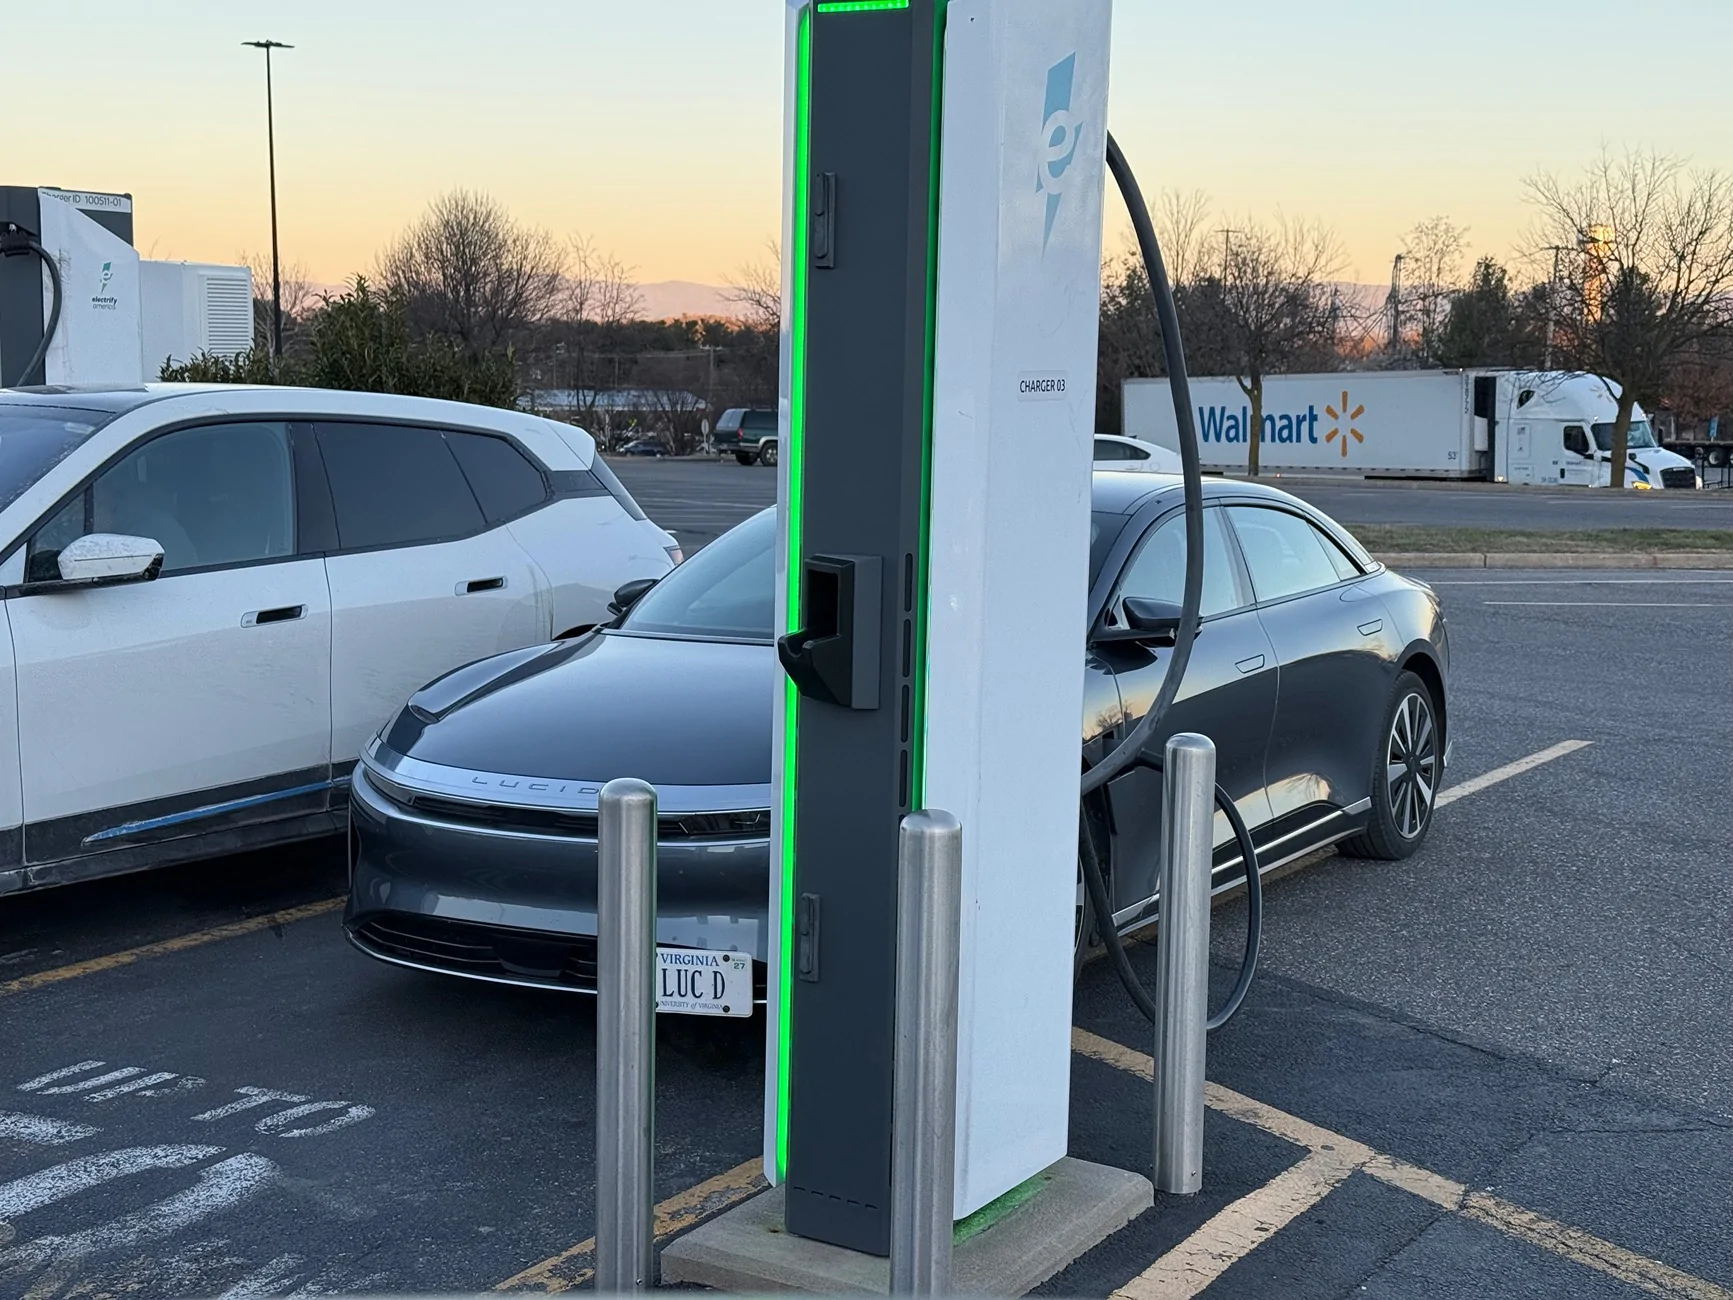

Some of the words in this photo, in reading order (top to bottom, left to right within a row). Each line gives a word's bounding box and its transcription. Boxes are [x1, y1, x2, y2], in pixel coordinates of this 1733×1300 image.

[72, 194, 81, 203] ID
[84, 195, 122, 207] 100511-01
[91, 296, 117, 305] electrify
[1019, 379, 1055, 393] CHARGER
[1056, 378, 1066, 392] 03
[1198, 404, 1319, 444] Walmart
[471, 775, 600, 796] LUCID
[660, 952, 720, 968] VIRGINIA
[733, 962, 746, 970] 27
[661, 967, 704, 999] LUC
[660, 1000, 689, 1009] NIVERSITY
[190, 1085, 377, 1138] TO
